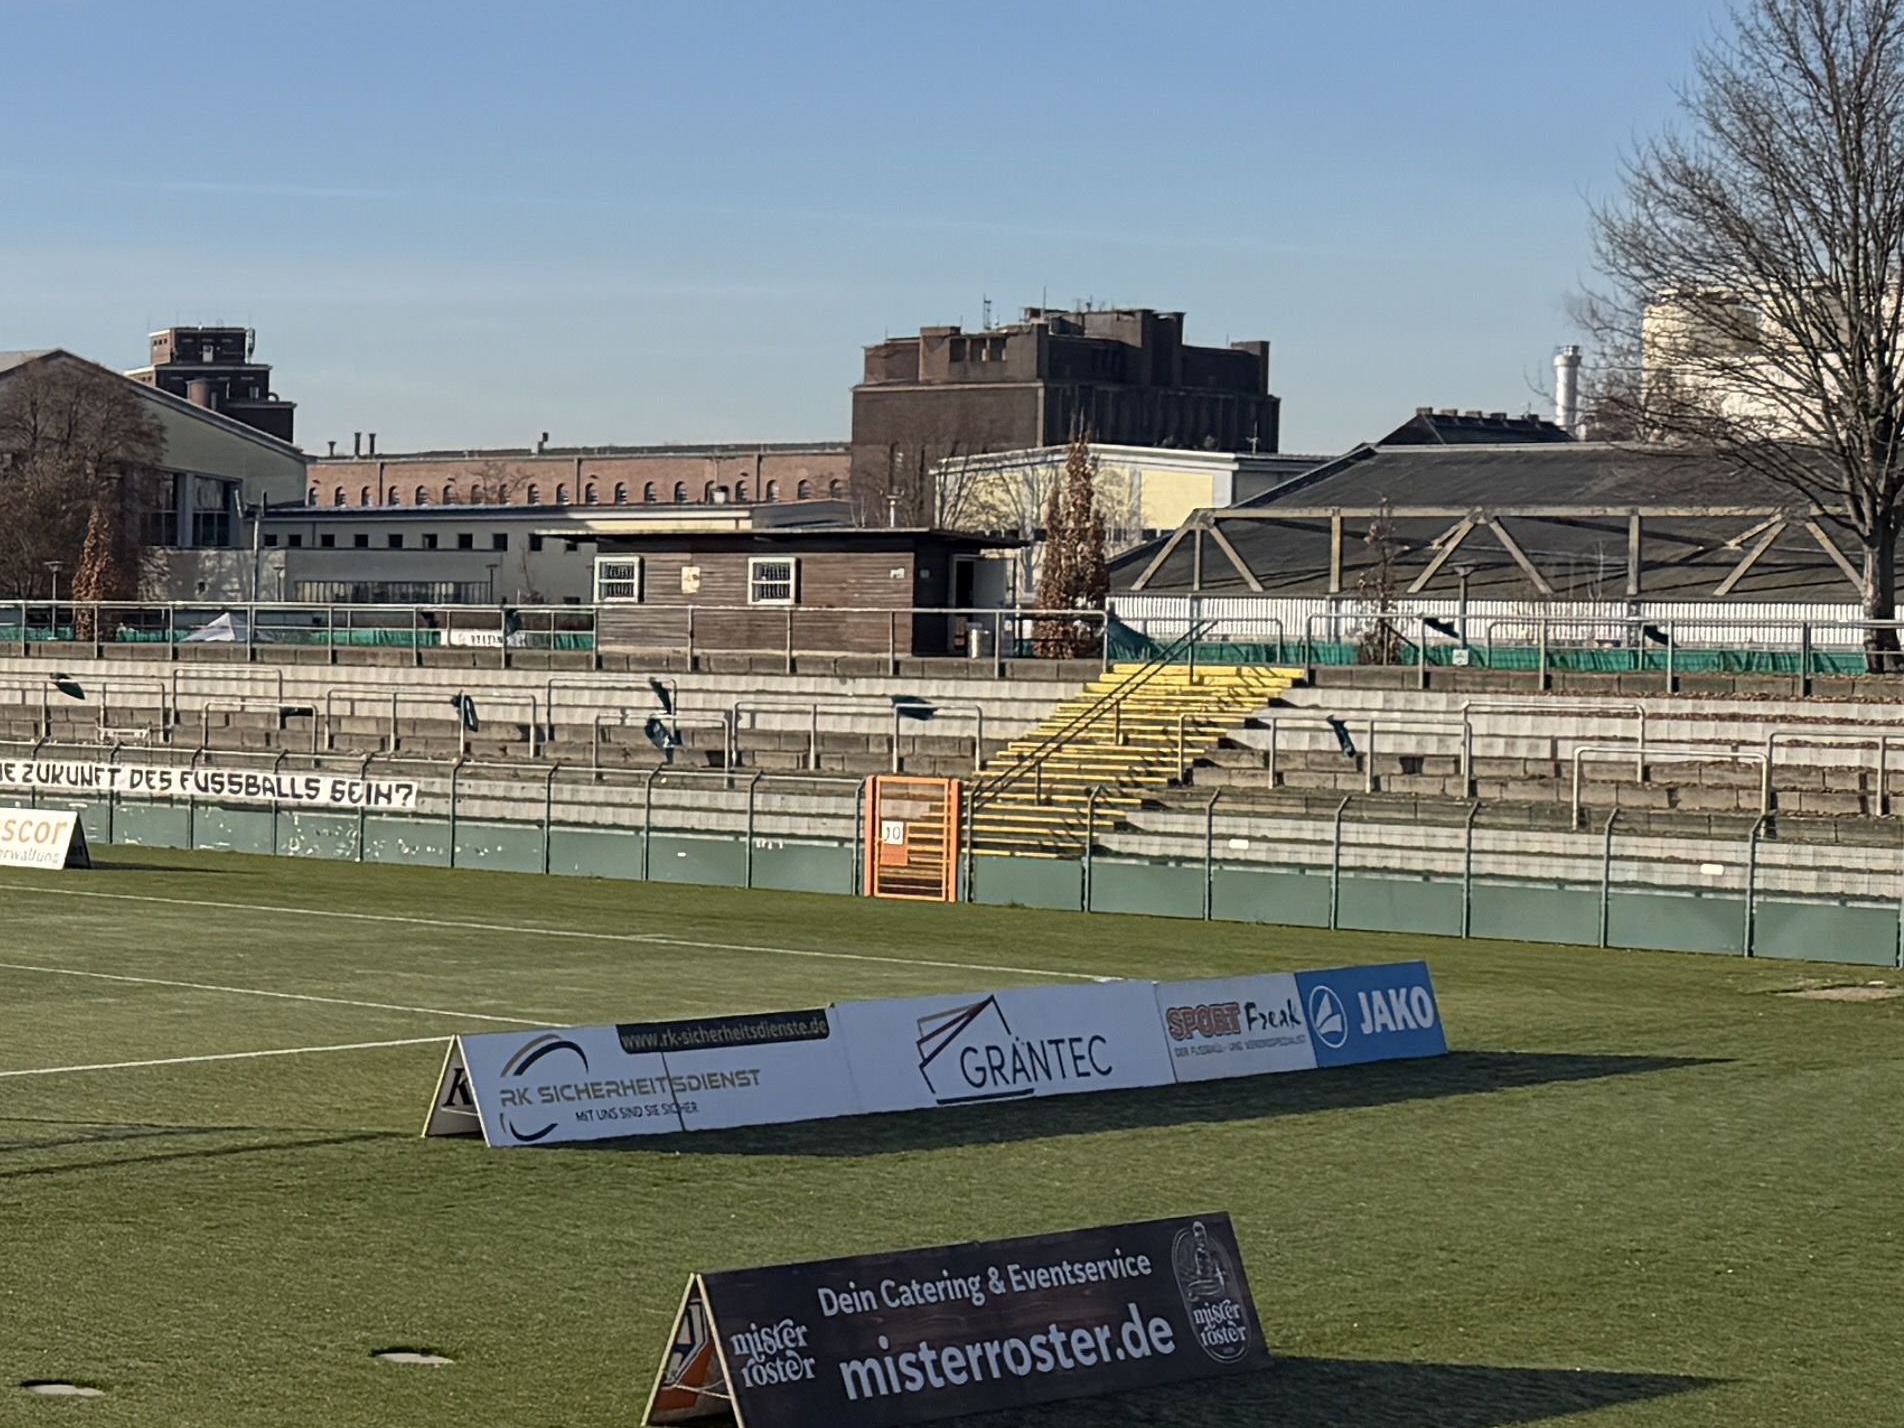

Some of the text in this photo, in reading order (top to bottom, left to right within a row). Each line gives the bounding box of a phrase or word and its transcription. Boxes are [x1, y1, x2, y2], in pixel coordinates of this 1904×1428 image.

[22, 762, 123, 788] ZUKUNFT
[129, 768, 172, 790] DES
[180, 769, 321, 801] FUSSBALLS
[330, 779, 414, 807] SEIN?
[884, 826, 901, 842] 10
[1166, 998, 1302, 1041] SPORT Freak
[1358, 985, 1435, 1035] JAKO
[621, 1018, 828, 1050] www.rk-sicherheitsdienste.de
[959, 1034, 1113, 1089] GRÄNTEC
[500, 1068, 761, 1108] RK SICHERHEITSDIENST
[575, 1108, 595, 1122] MIT
[596, 1106, 619, 1121] UNS
[619, 1104, 643, 1119] SIND
[643, 1103, 661, 1117] SIE
[817, 1247, 1152, 1317] Dein Catering & Eventservice
[1193, 1299, 1240, 1330] mister
[1200, 1322, 1246, 1347] roster
[730, 1318, 808, 1360] mister
[839, 1302, 1176, 1401] misterroster.de
[742, 1350, 816, 1388] roster
